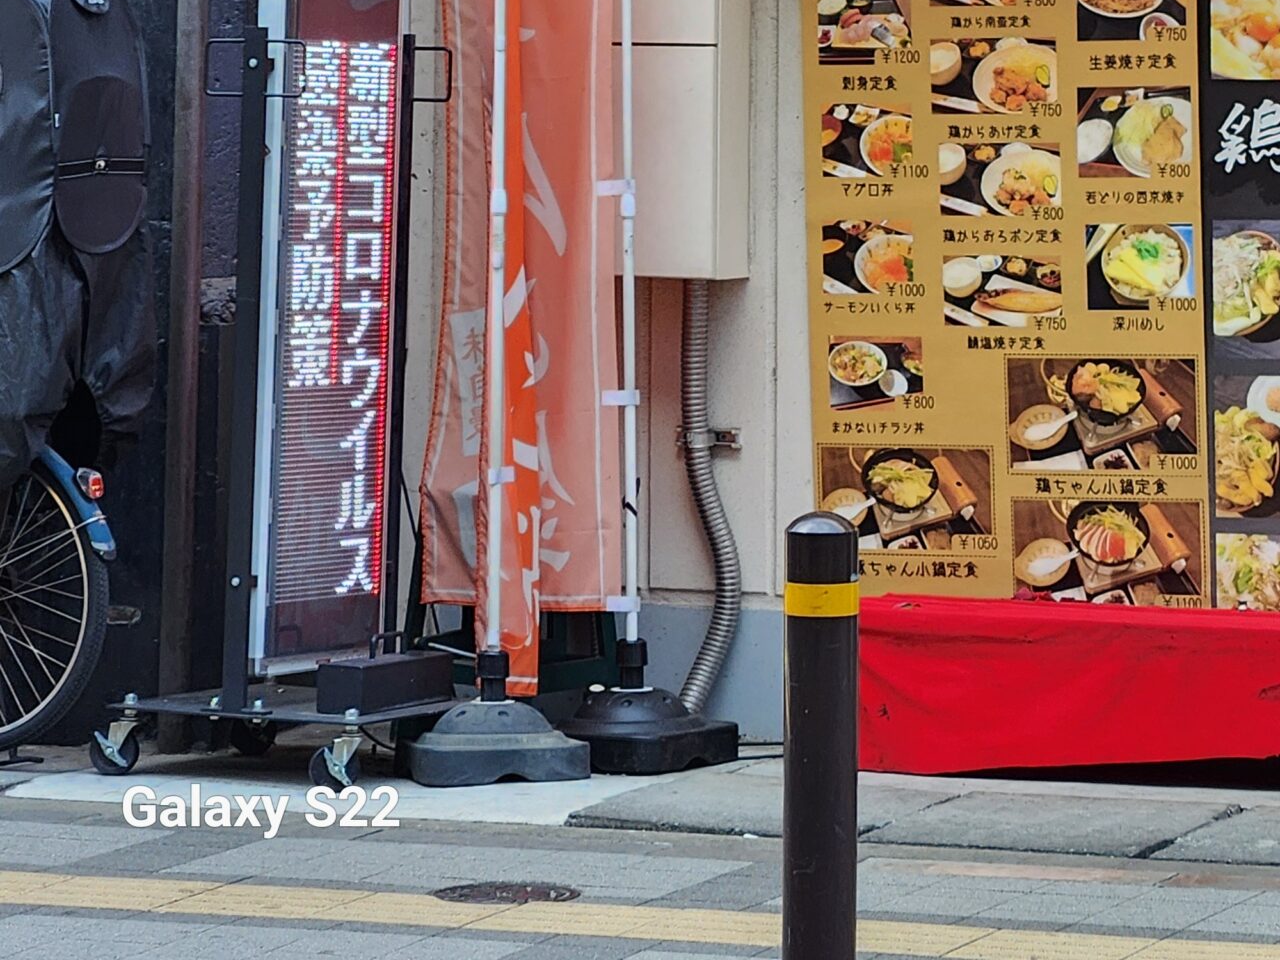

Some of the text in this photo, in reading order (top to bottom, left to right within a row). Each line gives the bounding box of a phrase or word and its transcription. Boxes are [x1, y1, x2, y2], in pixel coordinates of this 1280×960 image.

[1153, 27, 1187, 42] ¥750
[881, 50, 921, 64] ¥1200
[1089, 54, 1177, 71] 生姜焼き定食
[842, 75, 897, 91] 刺身定食
[1029, 103, 1062, 117] ¥750
[948, 125, 1042, 139] 鶏からあげ定食
[890, 164, 929, 178] ¥1100
[1157, 164, 1191, 178] ¥800
[841, 182, 894, 198] マグロ丼
[1031, 207, 1064, 221] ¥800
[885, 283, 926, 298] ¥1000
[824, 302, 916, 315] サーモンいくら丼
[1157, 297, 1197, 312] ¥1000
[1033, 316, 1067, 331] ¥750
[1112, 316, 1165, 333] 深川めし
[902, 395, 935, 410] ¥800
[831, 421, 925, 435] まかないチラシ丼
[1157, 456, 1198, 471] ¥1000
[1035, 477, 1168, 496] 鶏ちゃん小鍋定食
[958, 535, 998, 551] ¥1050
